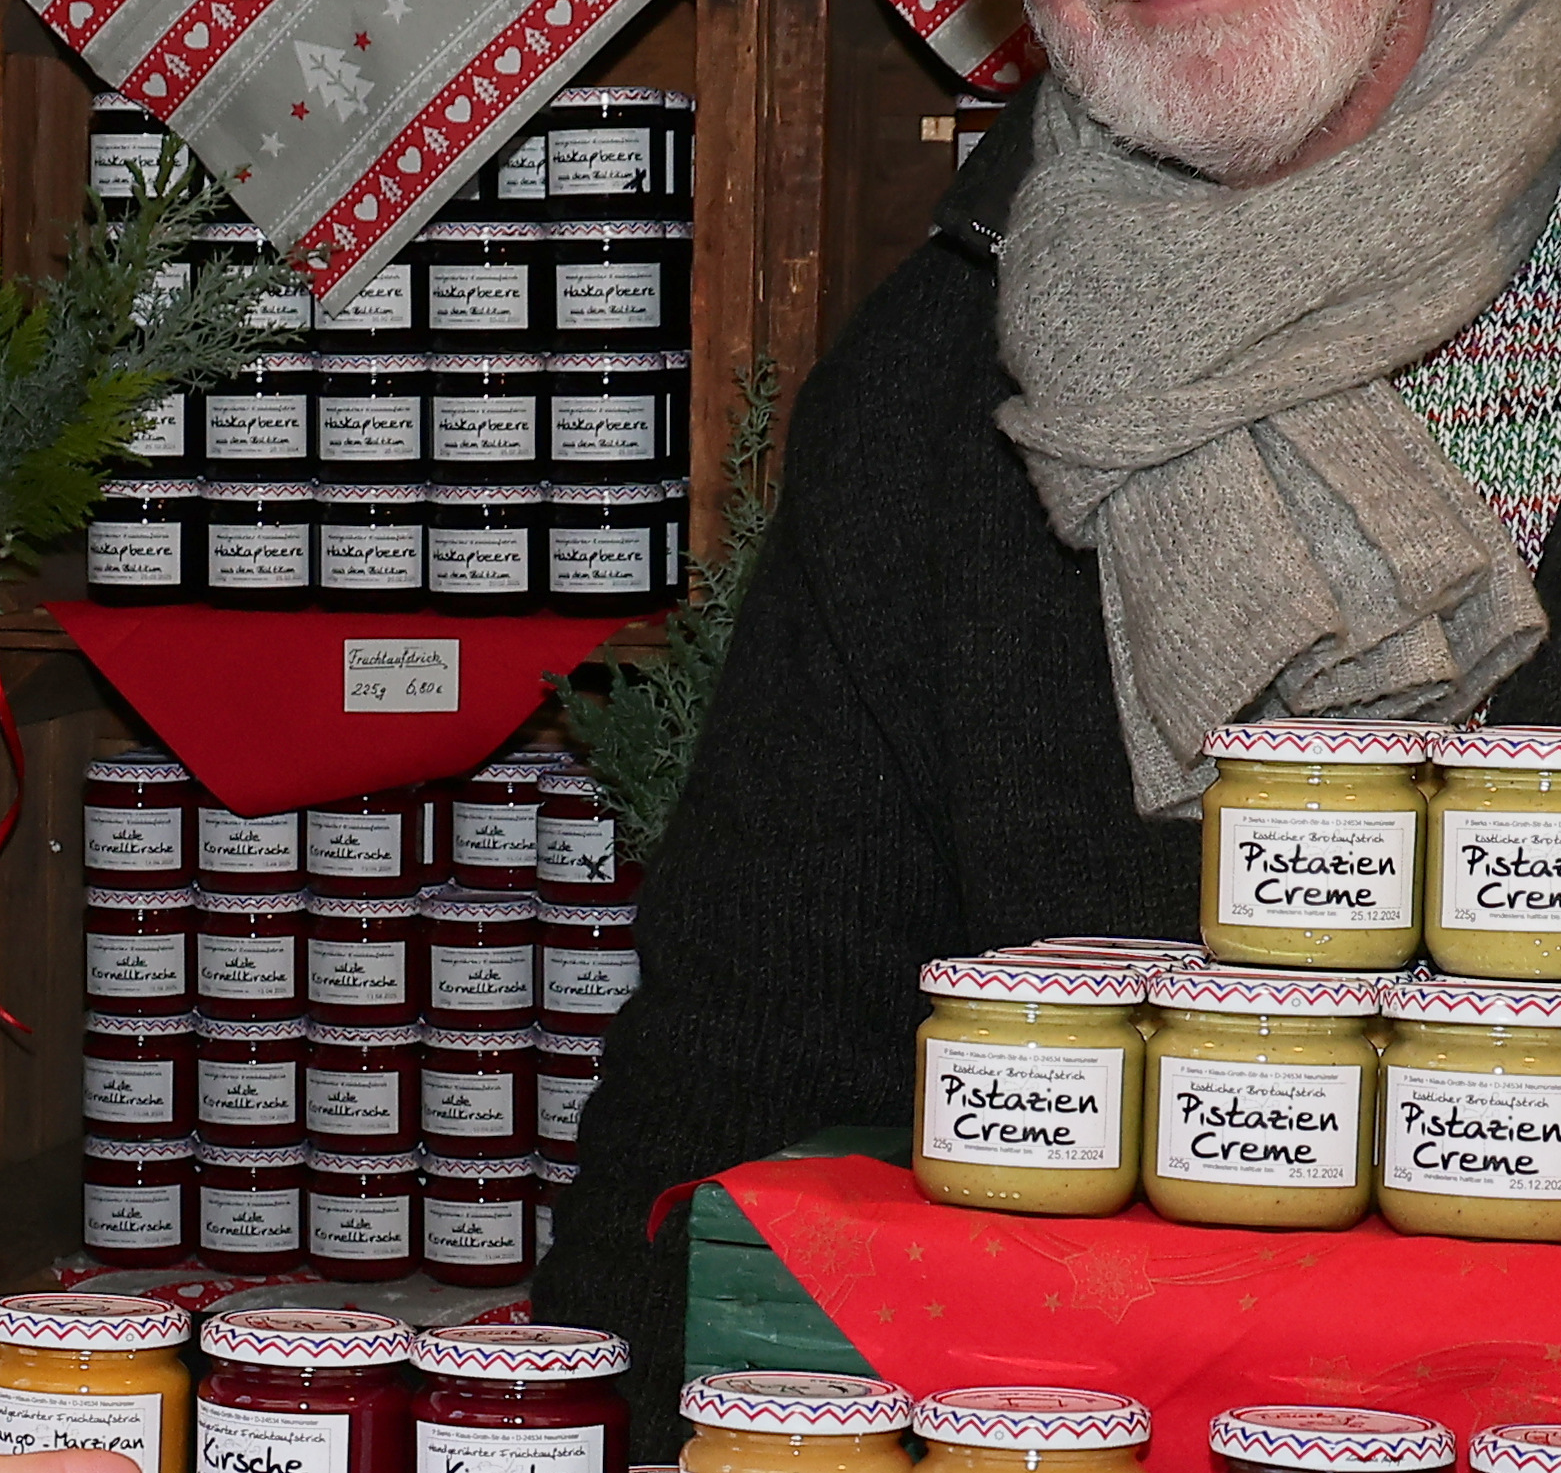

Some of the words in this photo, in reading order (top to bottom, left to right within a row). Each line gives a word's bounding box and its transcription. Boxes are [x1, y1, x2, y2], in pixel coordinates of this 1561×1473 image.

[1239, 841, 1398, 881] Pistazien
[1253, 877, 1378, 911] Creme
[941, 1073, 1100, 1115] Pistazien
[953, 1114, 1077, 1148] Creme
[1412, 1142, 1541, 1176] Creme
